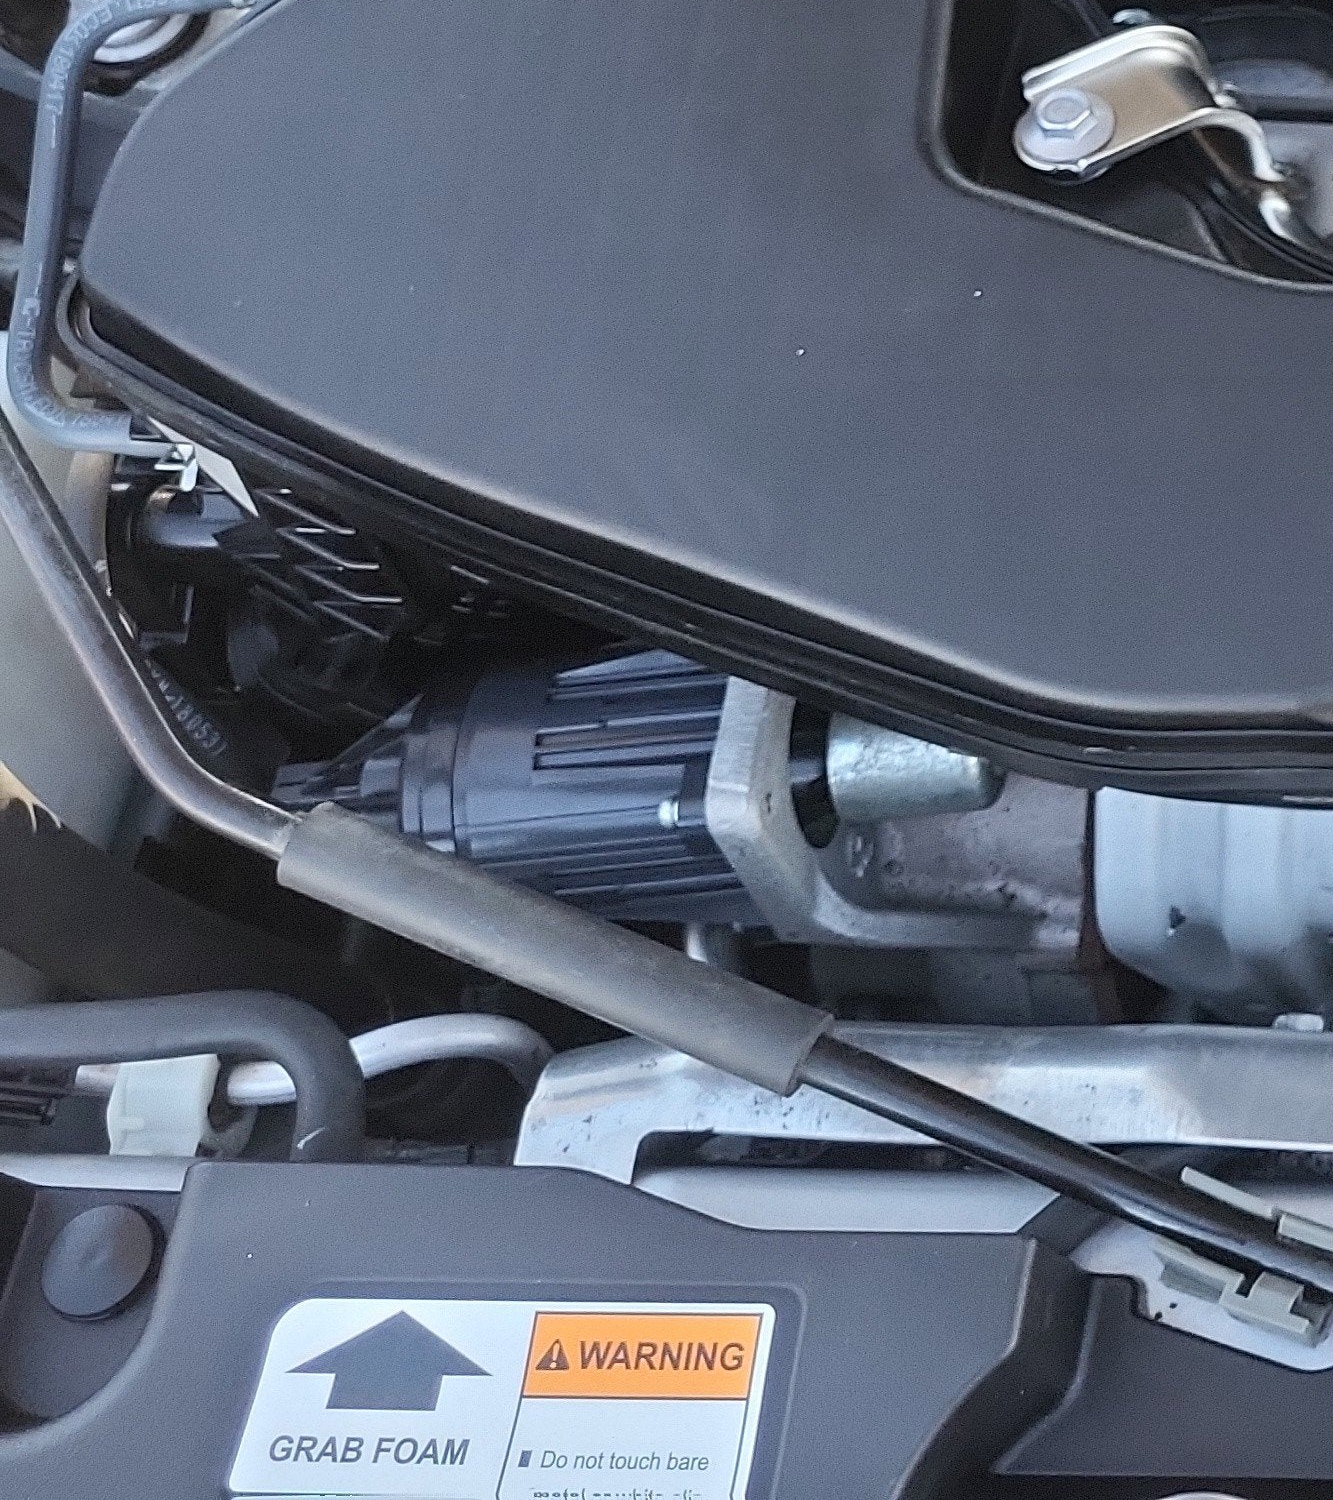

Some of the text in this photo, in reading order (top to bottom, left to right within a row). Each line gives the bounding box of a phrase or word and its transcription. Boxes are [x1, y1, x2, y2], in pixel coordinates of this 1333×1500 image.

[578, 1340, 747, 1371] WARNING
[268, 1435, 471, 1466] GRAB FOAM
[540, 1450, 709, 1471] Do not touch bare
